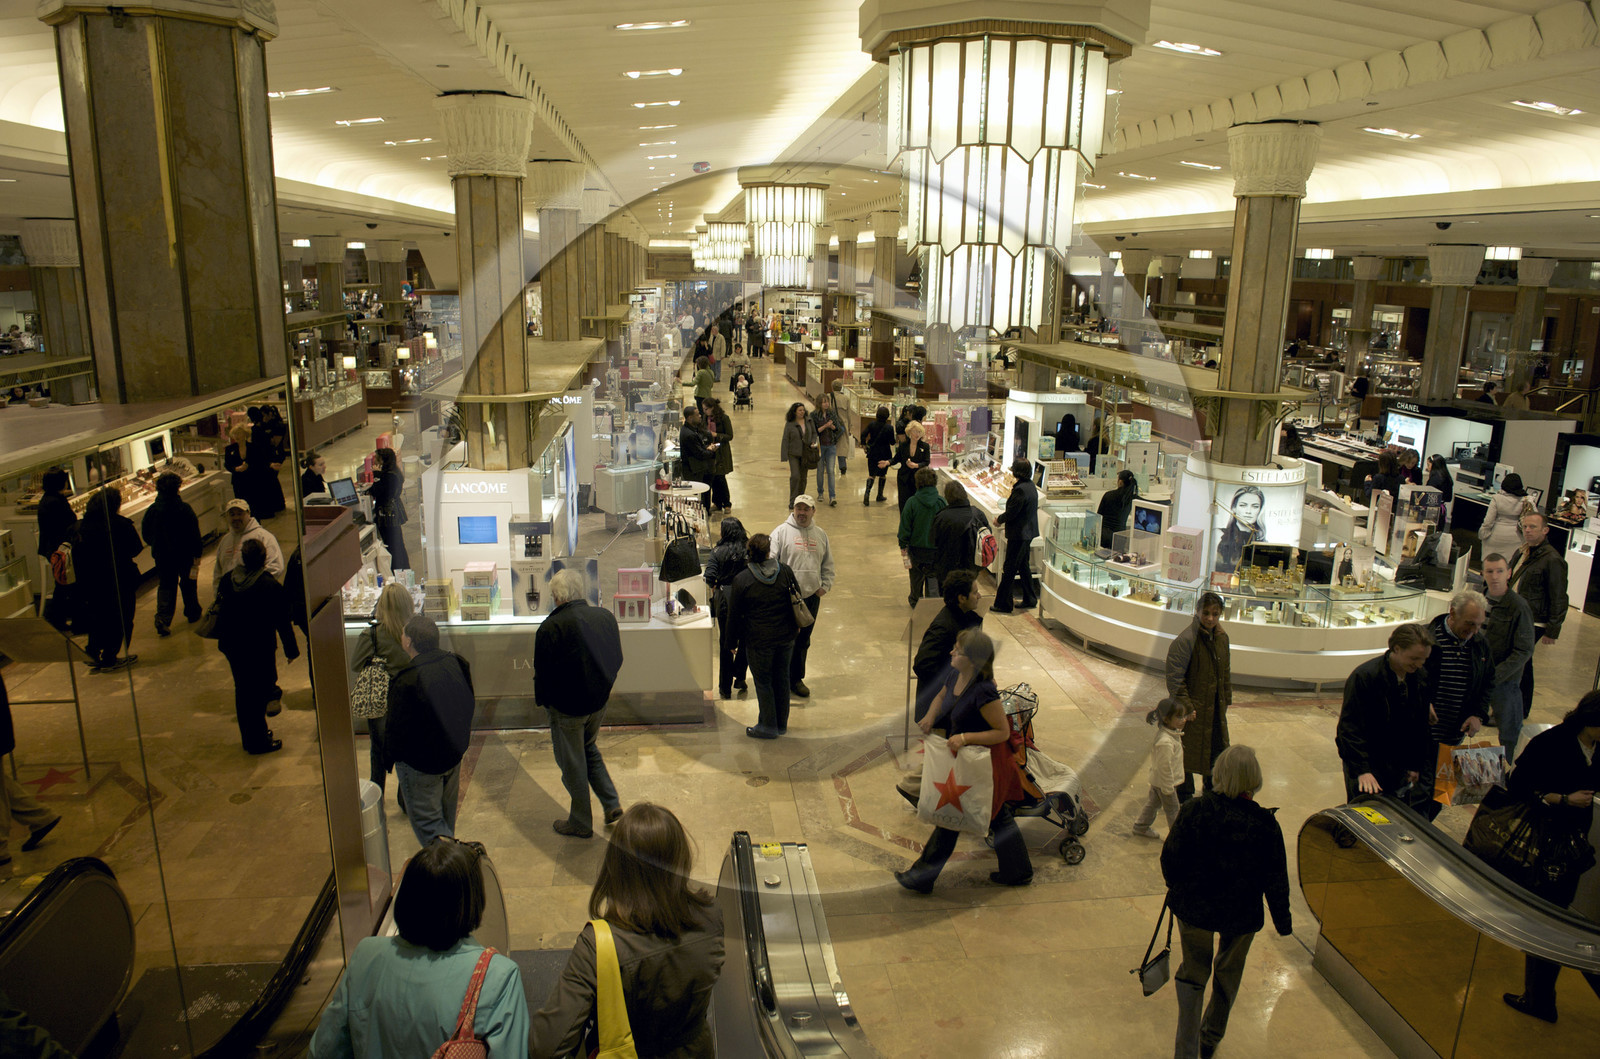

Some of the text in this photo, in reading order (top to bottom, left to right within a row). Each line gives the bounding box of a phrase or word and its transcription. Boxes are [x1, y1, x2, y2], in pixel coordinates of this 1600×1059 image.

[549, 395, 582, 404] NCÔME
[1396, 402, 1420, 413] CHANEL
[444, 481, 508, 494] LANCÔME
